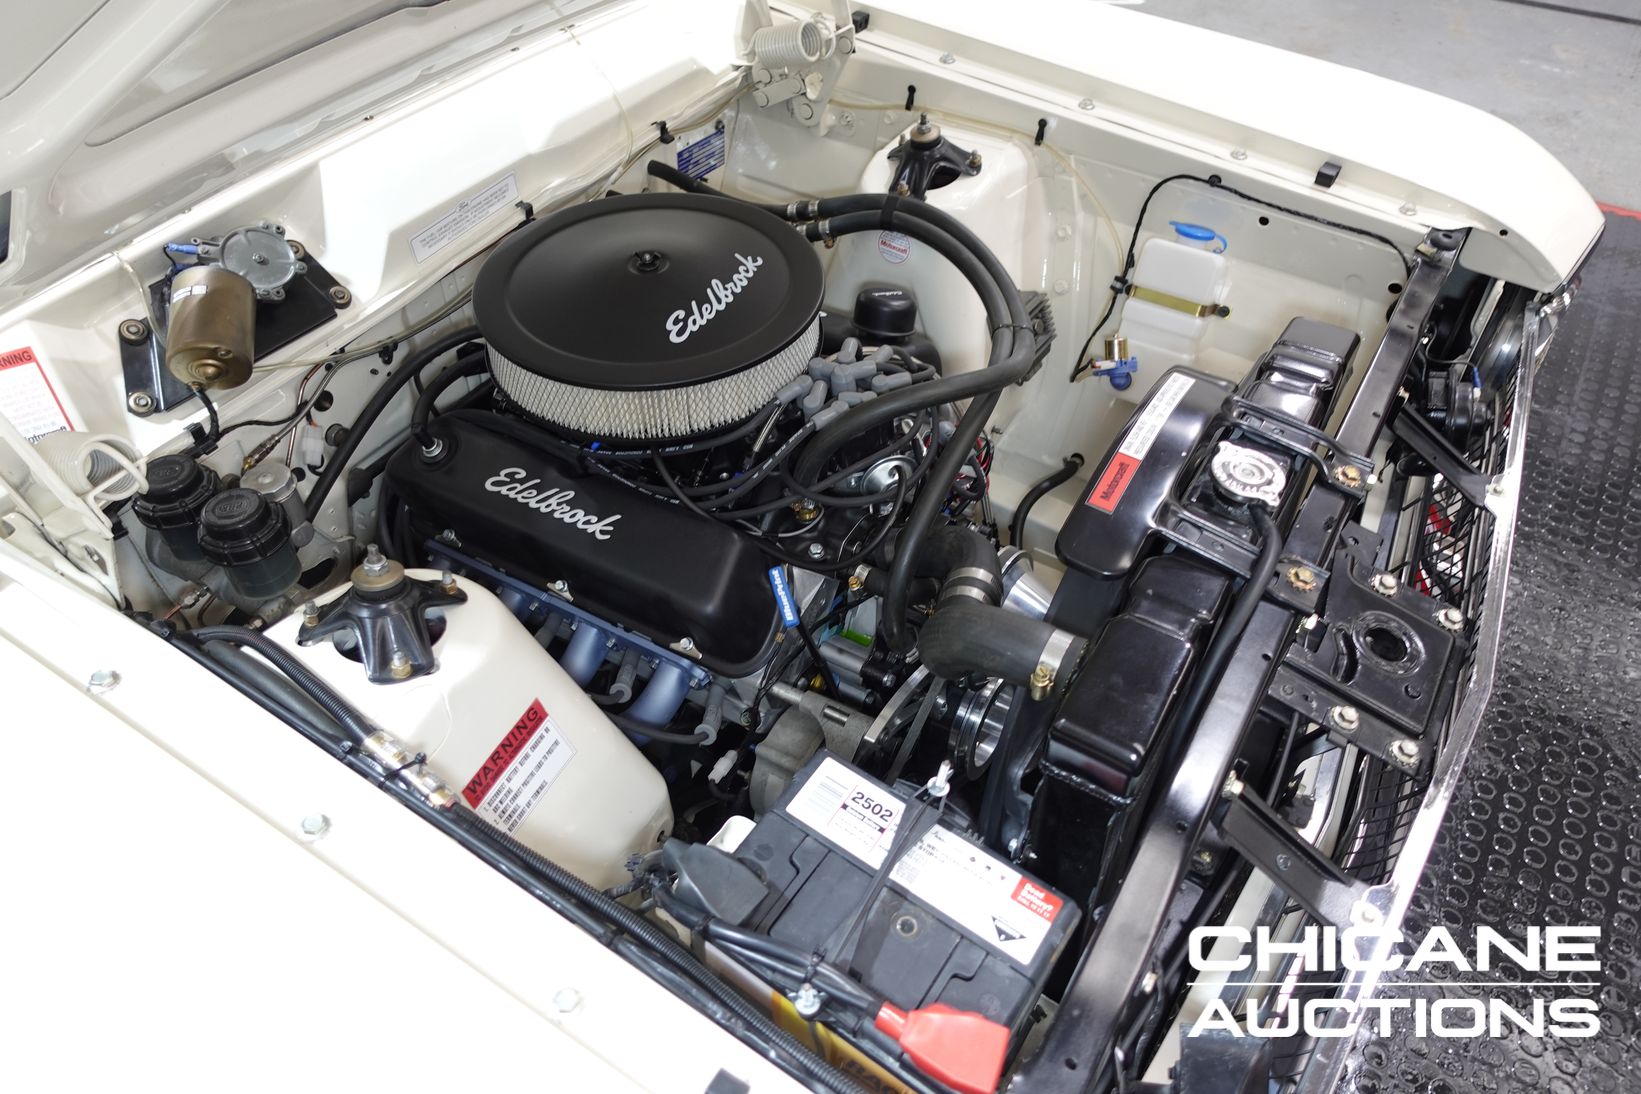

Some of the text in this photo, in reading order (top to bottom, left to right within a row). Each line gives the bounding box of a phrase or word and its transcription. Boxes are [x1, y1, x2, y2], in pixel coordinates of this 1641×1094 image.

[666, 253, 763, 343] Edelbrock
[485, 468, 621, 539] Edelbrock
[1099, 459, 1129, 502] Motorcraft
[467, 707, 538, 793] WARNING
[850, 790, 893, 822] 2502
